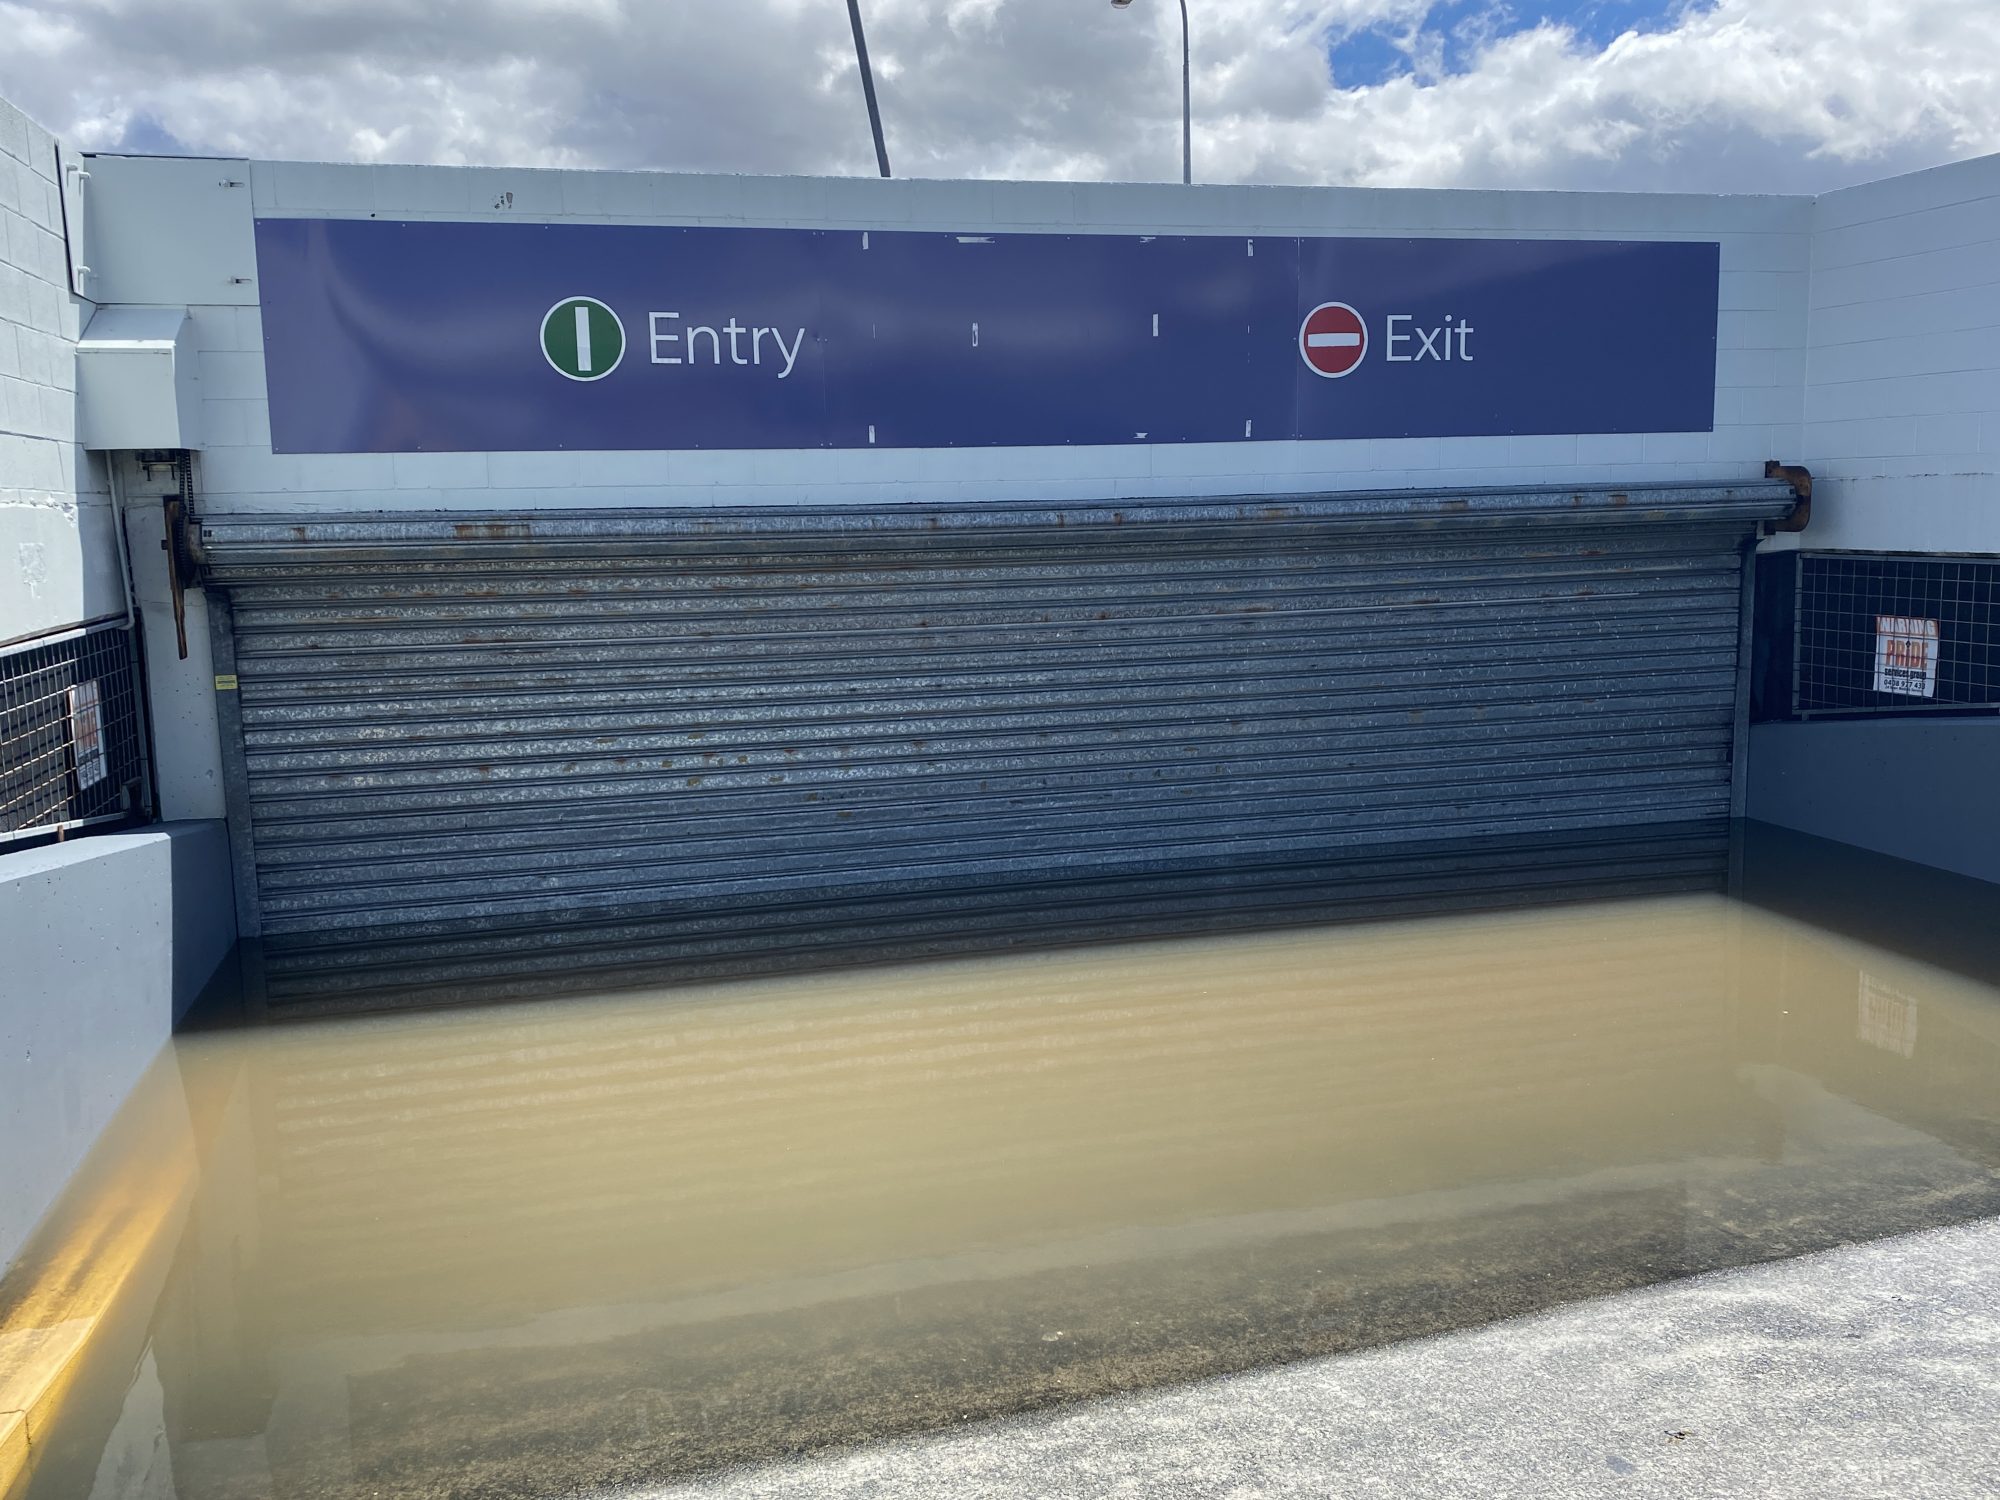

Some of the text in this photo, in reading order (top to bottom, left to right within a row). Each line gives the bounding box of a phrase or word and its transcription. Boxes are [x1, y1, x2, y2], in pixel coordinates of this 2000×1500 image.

[649, 311, 805, 379] Entry
[1386, 314, 1474, 362] Exit
[1885, 640, 1928, 670] PRIDE
